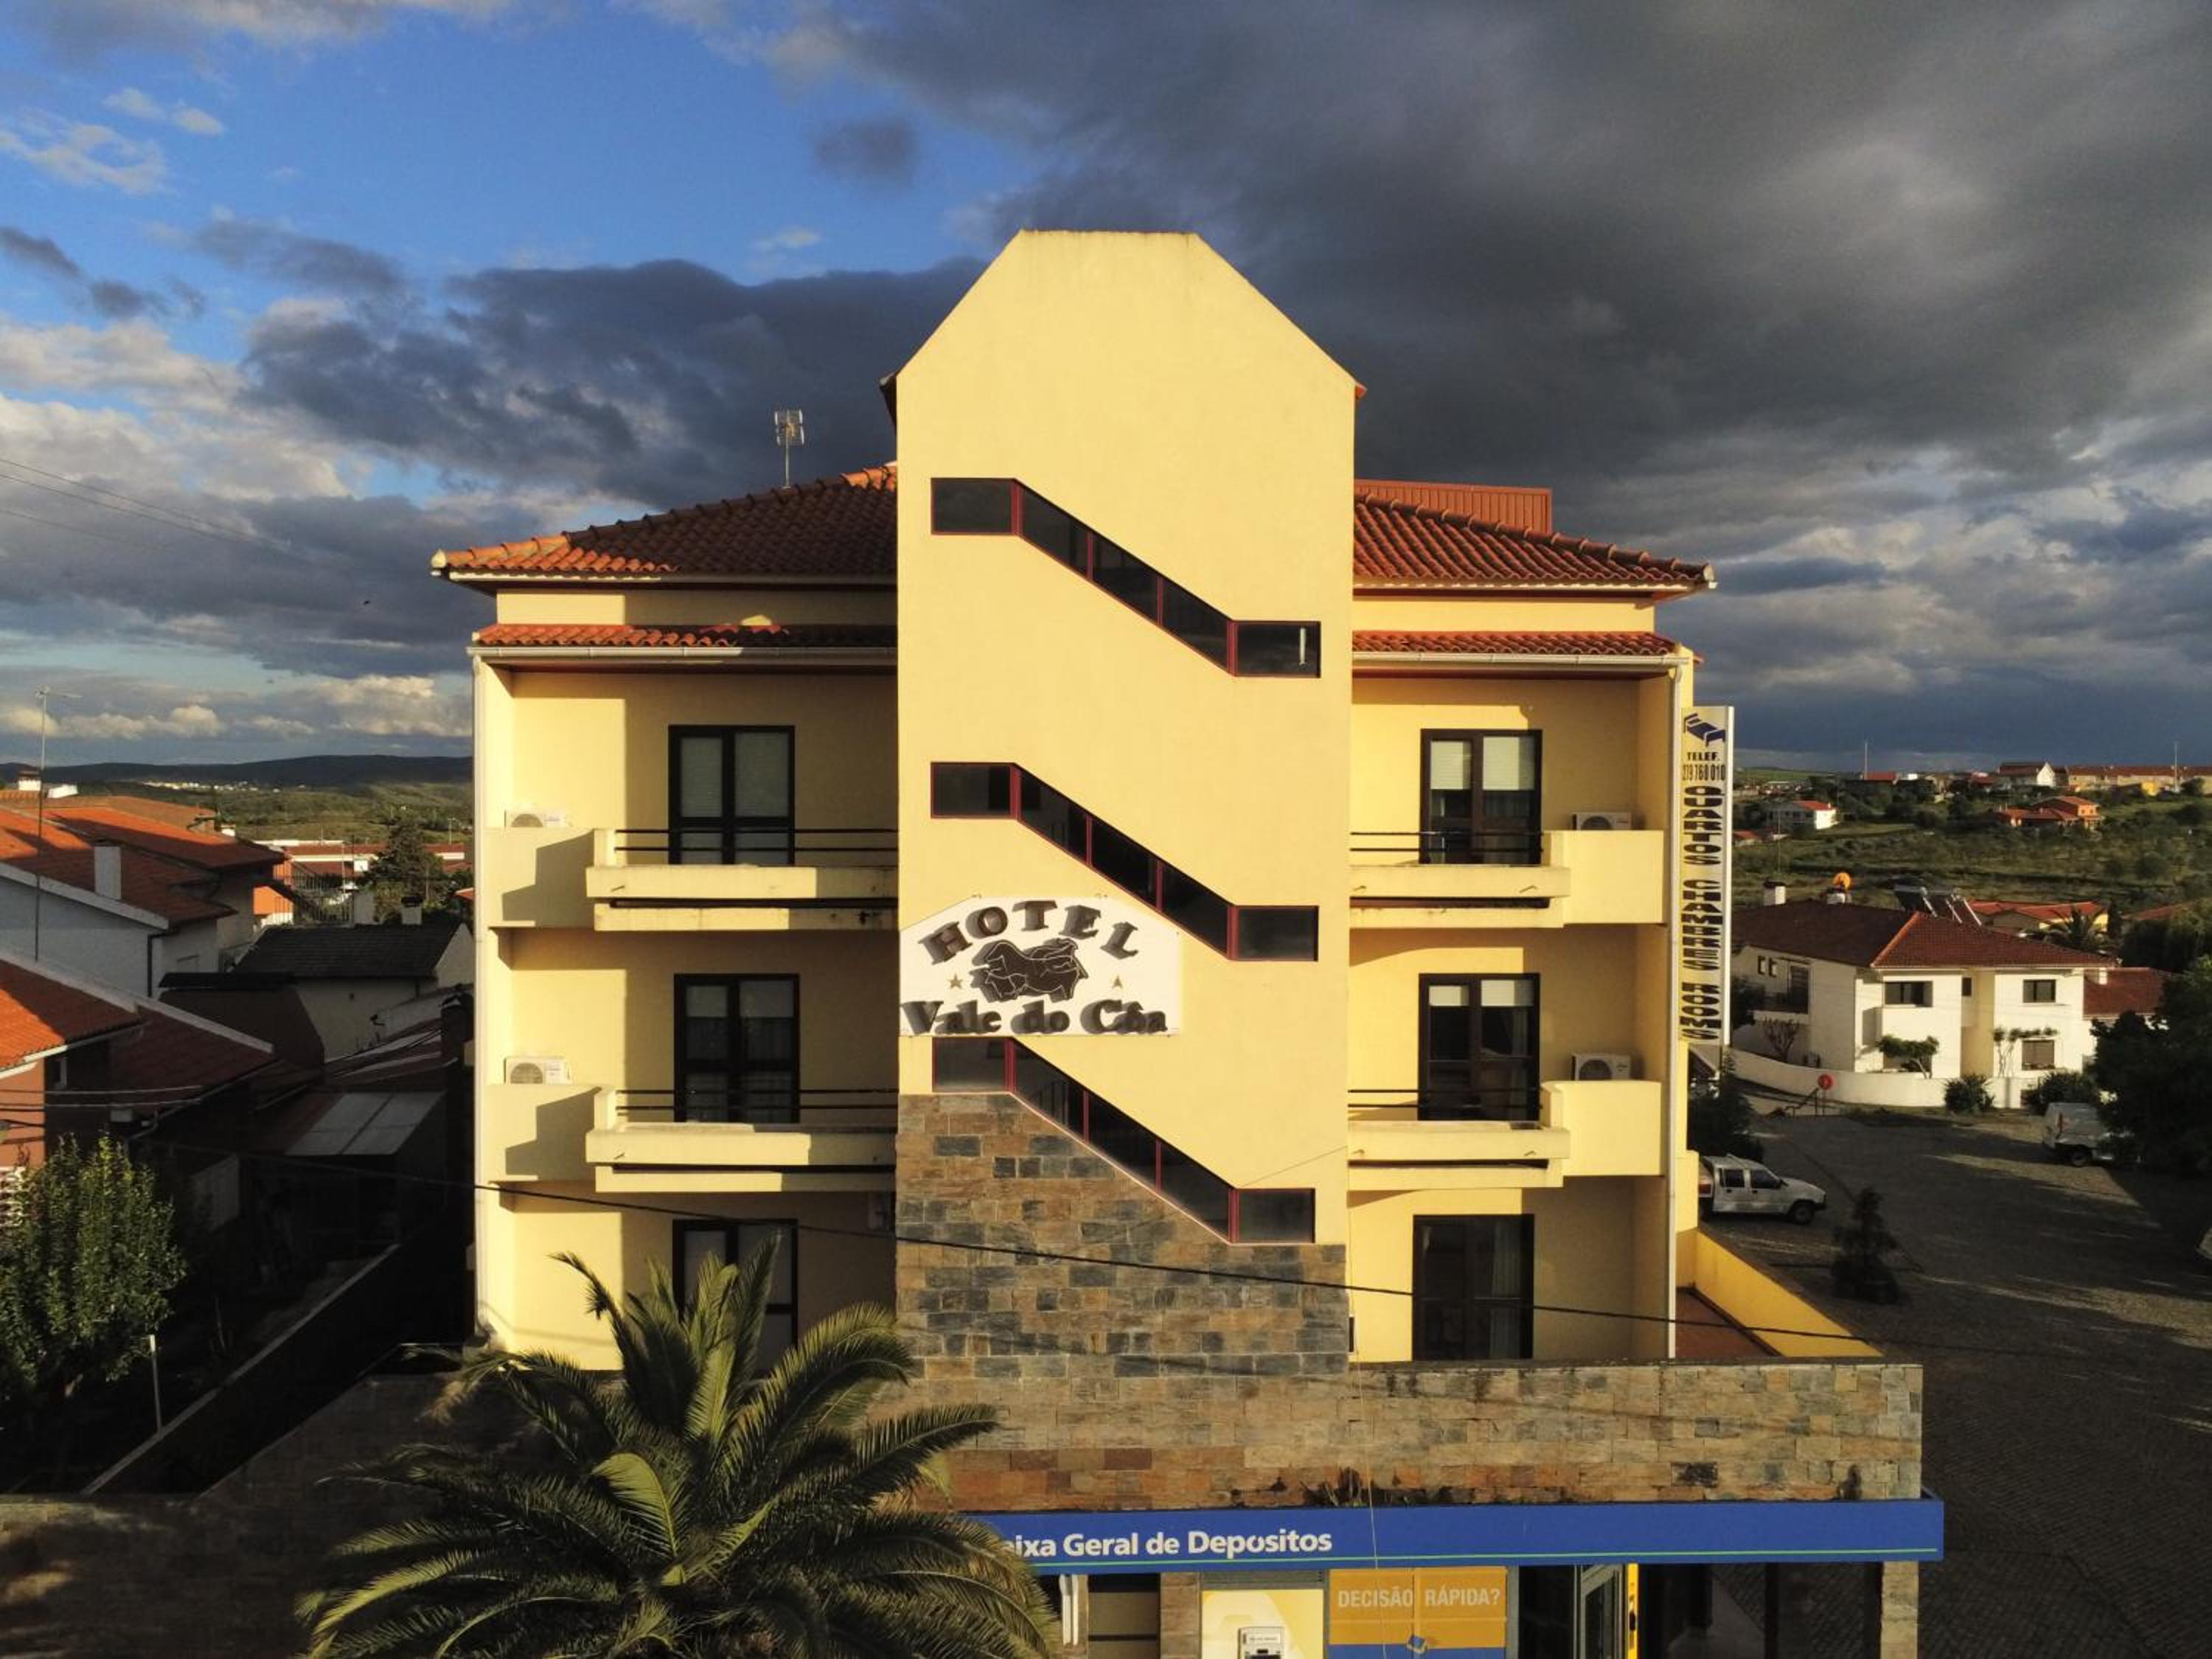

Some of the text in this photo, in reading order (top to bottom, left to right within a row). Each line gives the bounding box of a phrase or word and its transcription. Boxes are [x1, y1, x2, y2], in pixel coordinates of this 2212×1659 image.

[1687, 751, 1720, 761] TELEF.
[1711, 764, 1726, 781] 010
[1683, 785, 1725, 866] QUARTOS
[918, 900, 1139, 965] HOTEL
[1681, 879, 1723, 971] CHAMBRES
[900, 1000, 1003, 1035] Vale
[1010, 1000, 1070, 1034] do
[1679, 981, 1722, 1040] ROOMS
[1062, 1532, 1138, 1557] Geral
[1145, 1531, 1180, 1555] de
[1338, 1585, 1500, 1607] DECISÃO RÁPIDA?
